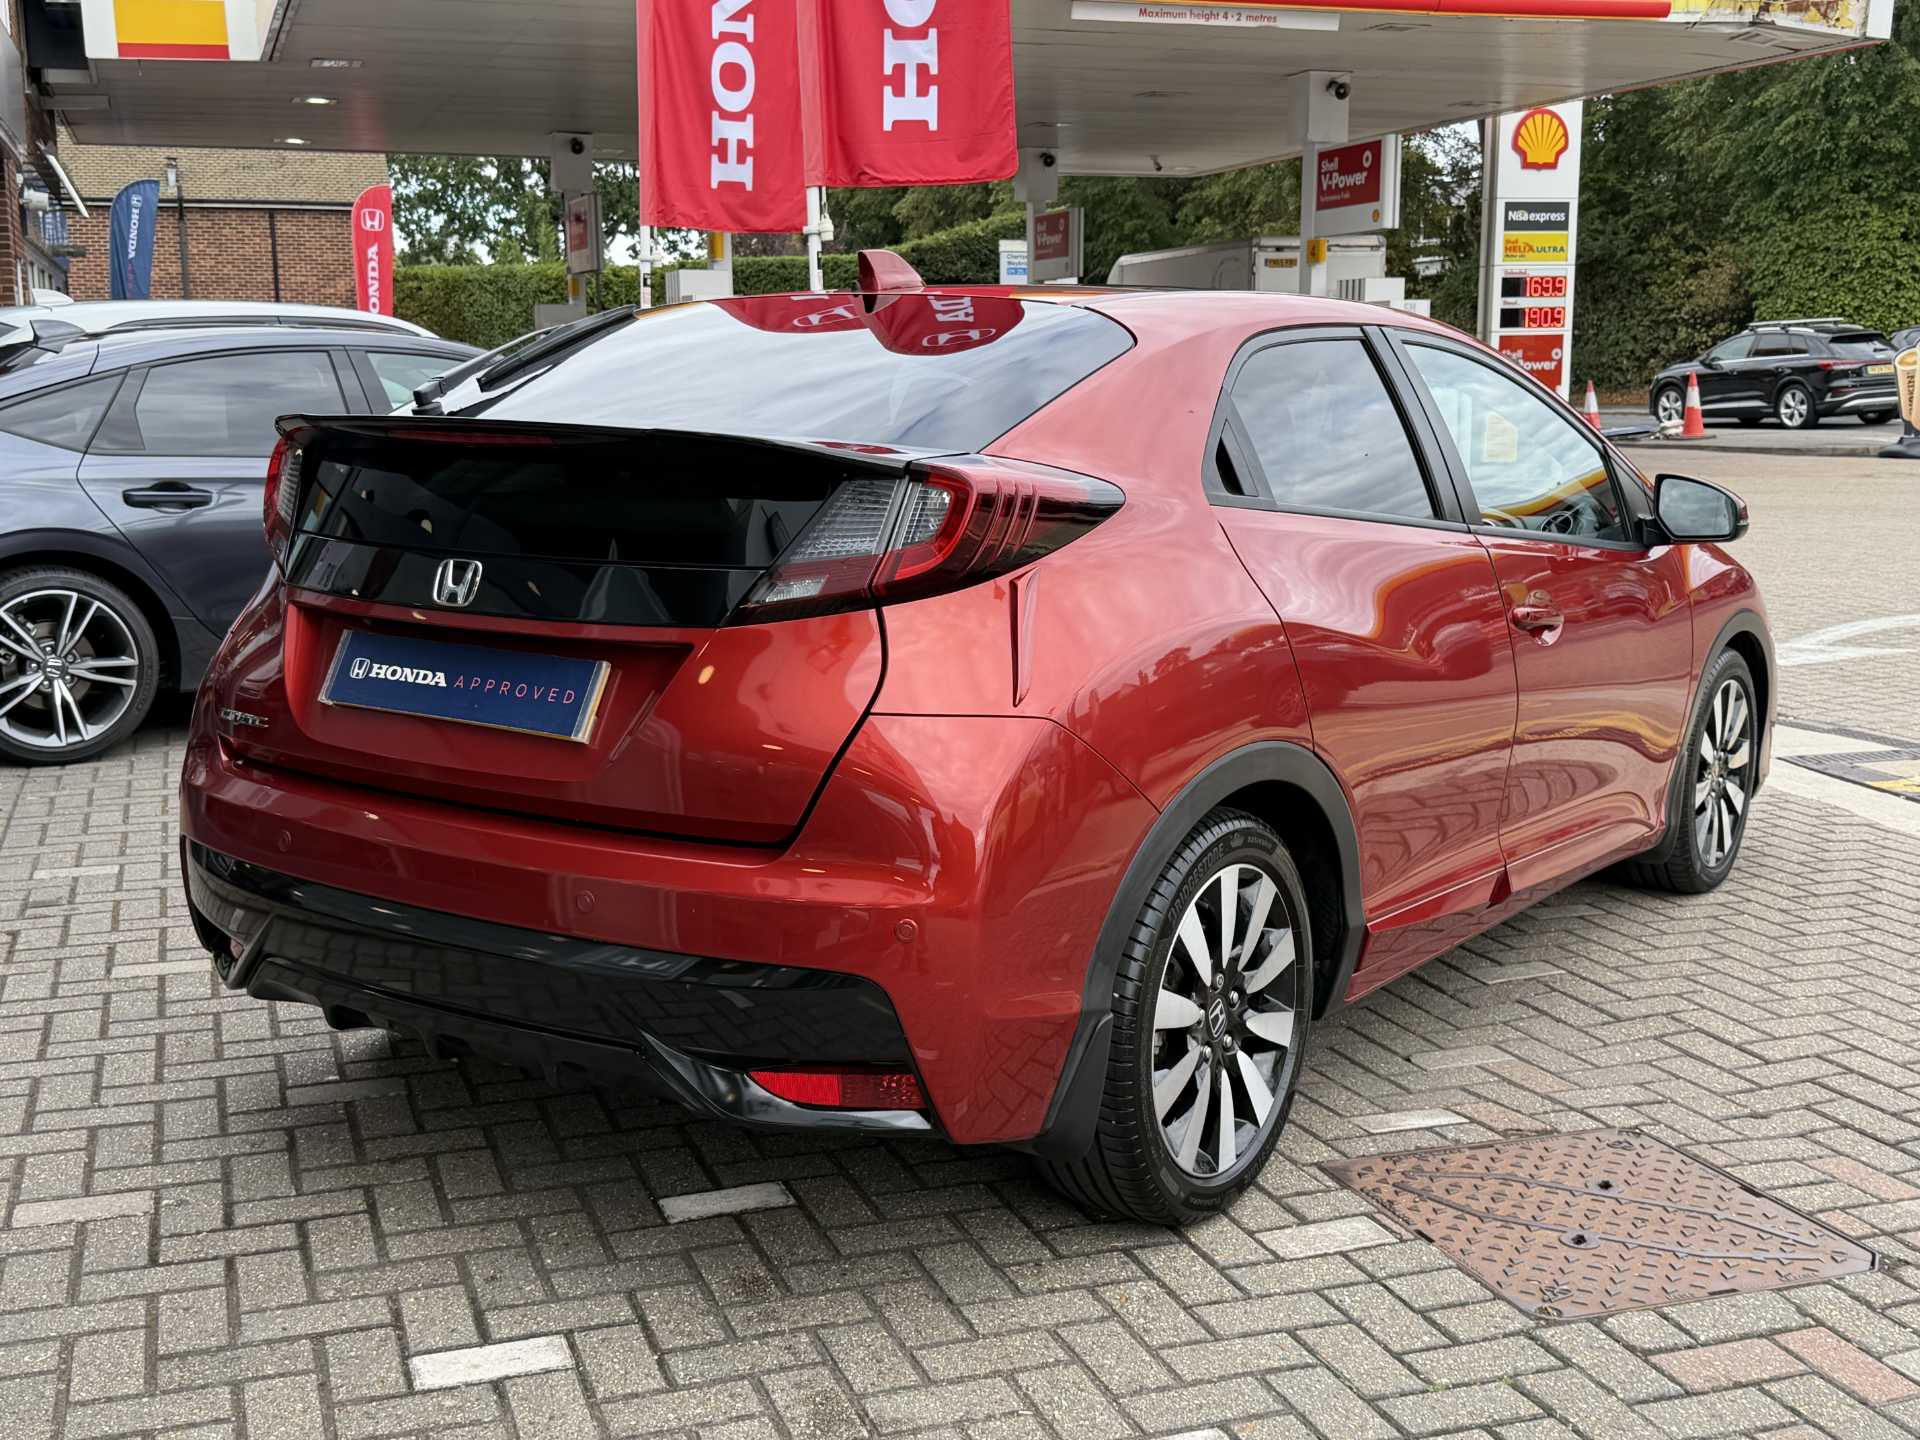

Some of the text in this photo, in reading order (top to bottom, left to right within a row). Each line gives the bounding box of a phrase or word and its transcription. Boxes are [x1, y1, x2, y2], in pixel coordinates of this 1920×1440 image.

[1139, 7, 1187, 20] Maximum
[1189, 9, 1219, 22] height
[1245, 13, 1277, 23] metres
[883, 0, 939, 131] H
[1321, 157, 1339, 173] Shell
[1321, 170, 1368, 191] V-Power
[127, 207, 140, 260] HONDA
[1526, 277, 1566, 297] 169.9
[1524, 308, 1565, 328] 190.9
[369, 663, 576, 704] HONDA APPROVED
